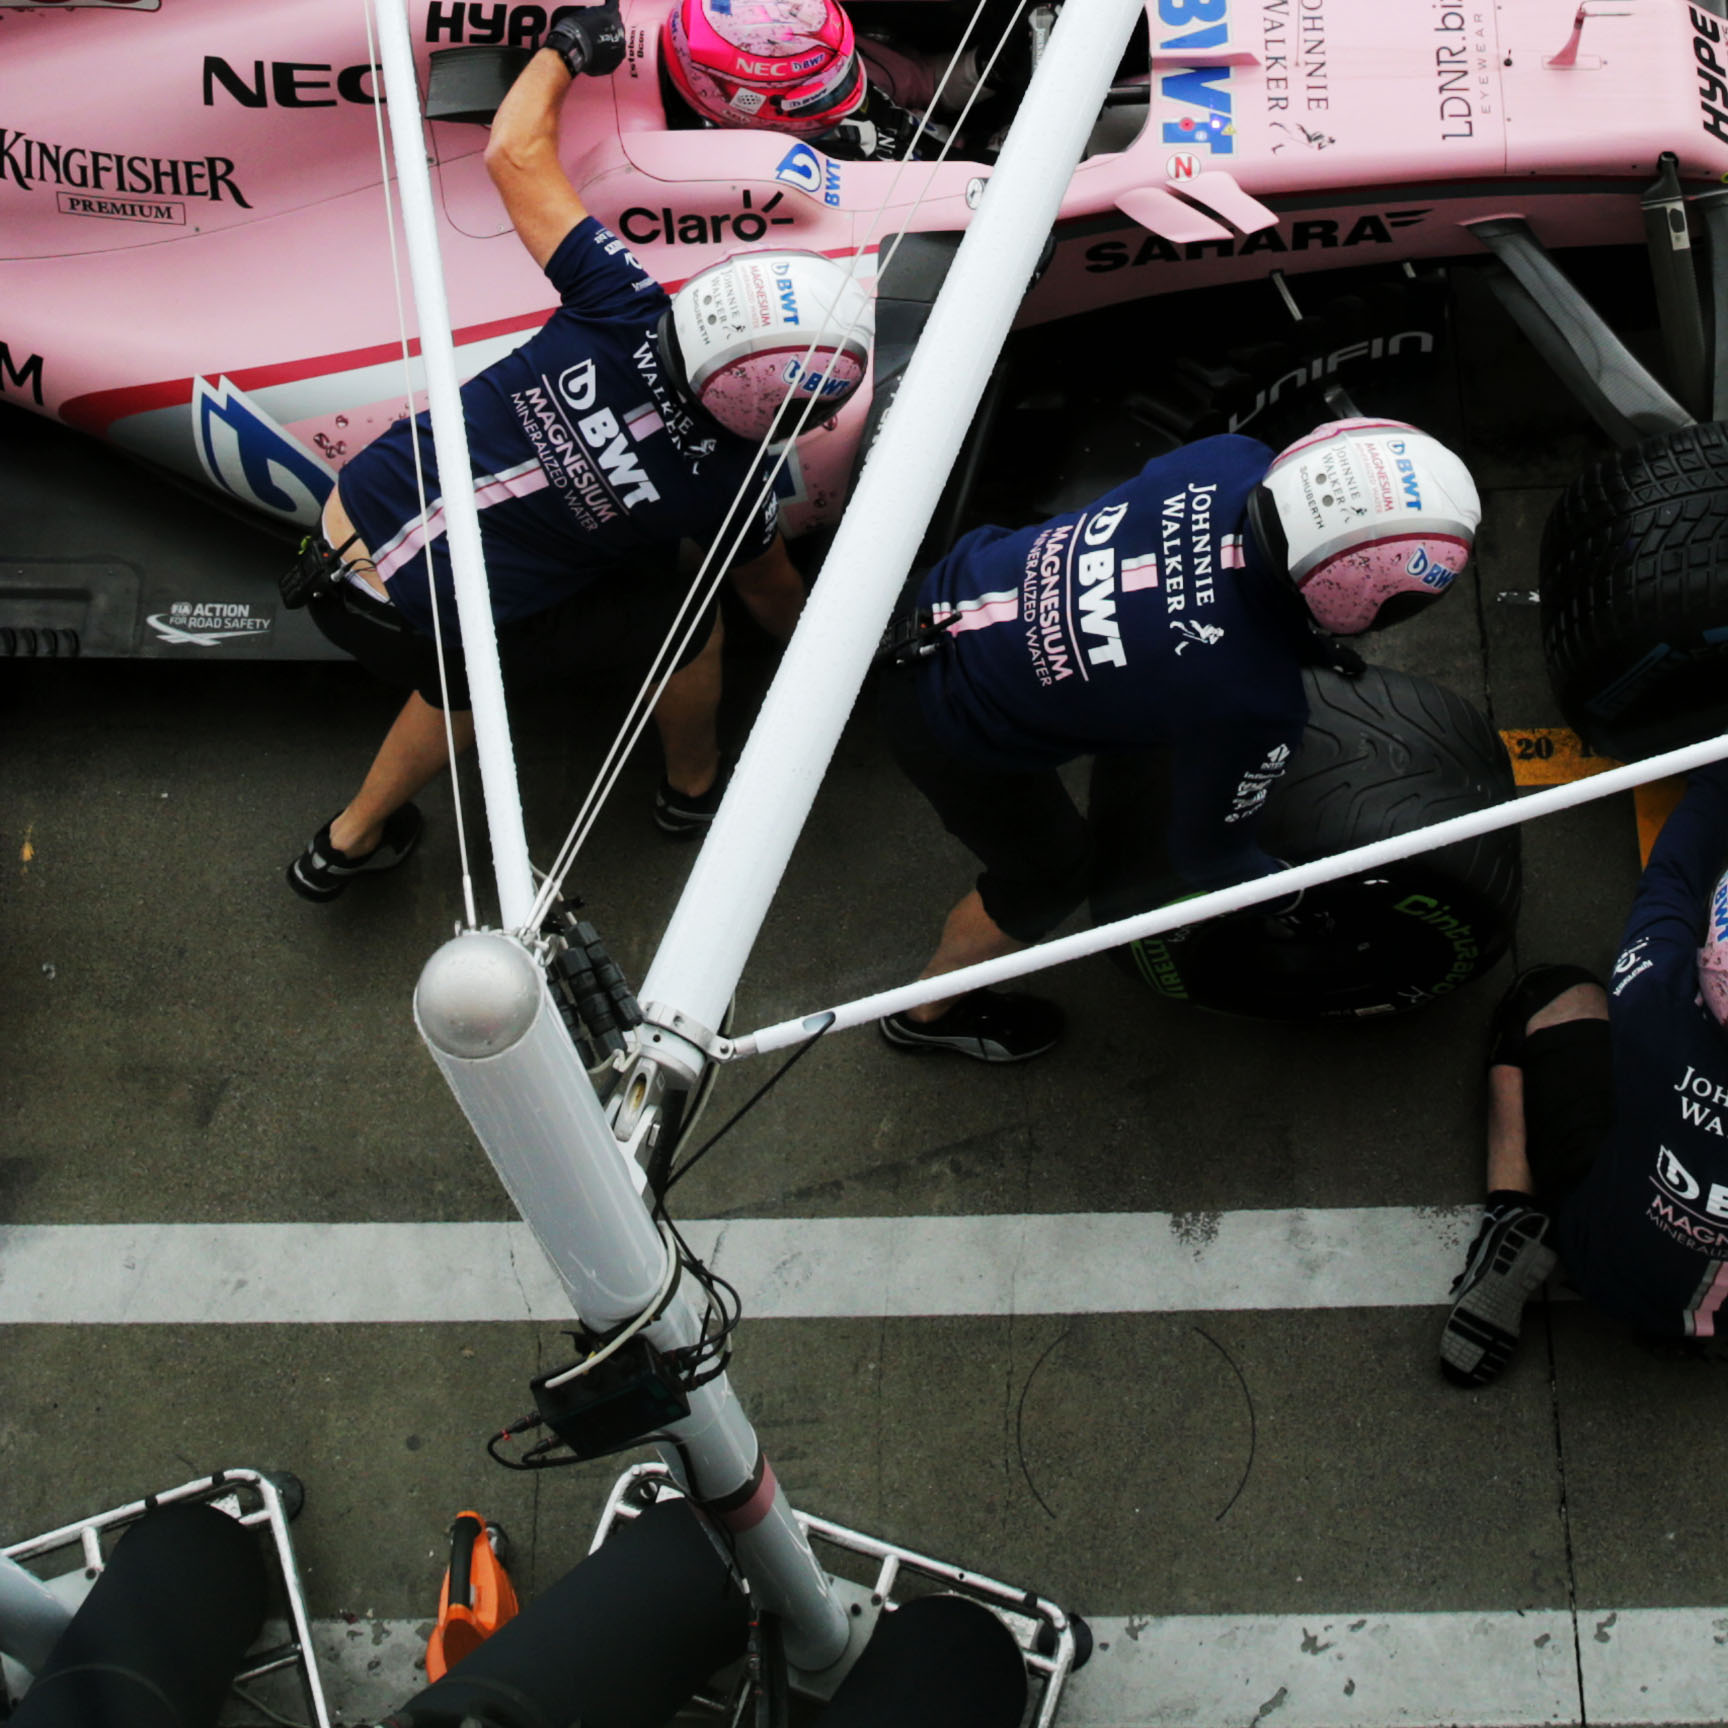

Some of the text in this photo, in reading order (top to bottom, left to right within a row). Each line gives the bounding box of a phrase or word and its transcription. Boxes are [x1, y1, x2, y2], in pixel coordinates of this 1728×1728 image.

[203, 56, 388, 109] NEC
[736, 59, 787, 76] NEC
[1474, 13, 1491, 114] EYEWEAR
[825, 156, 842, 206] BWT
[1175, 156, 1192, 178] N
[69, 197, 173, 220] PREMIUM
[619, 205, 768, 245] Claro
[693, 289, 710, 345] SCHUBERTH
[712, 277, 727, 322] WALKER
[724, 269, 741, 319] JOHNNIE
[749, 266, 771, 327] MAGNESIUM
[777, 279, 799, 325] BWT
[803, 373, 850, 395] BWT
[511, 392, 599, 534] MINERALIZED WATER
[524, 388, 617, 524] MAGNESIUM
[578, 409, 661, 511] BWT
[1323, 452, 1345, 506] WALKER
[1332, 445, 1361, 499] JOHNNIE
[1364, 442, 1394, 512] MAGNESIUM
[1300, 465, 1324, 530] SCHUBERTH
[1396, 458, 1422, 512] BWT
[1160, 492, 1187, 617] WALKER
[1188, 482, 1217, 606] JOHNNIE
[1423, 564, 1459, 589] BW
[188, 617, 222, 628] ROAD
[224, 618, 271, 629] SAFETY
[193, 603, 249, 617] ACTION
[1023, 528, 1053, 688] MINERALIZED WATER
[1040, 526, 1075, 682] MAGNESIUM
[1078, 548, 1128, 669] BWT
[1517, 737, 1554, 760] 20
